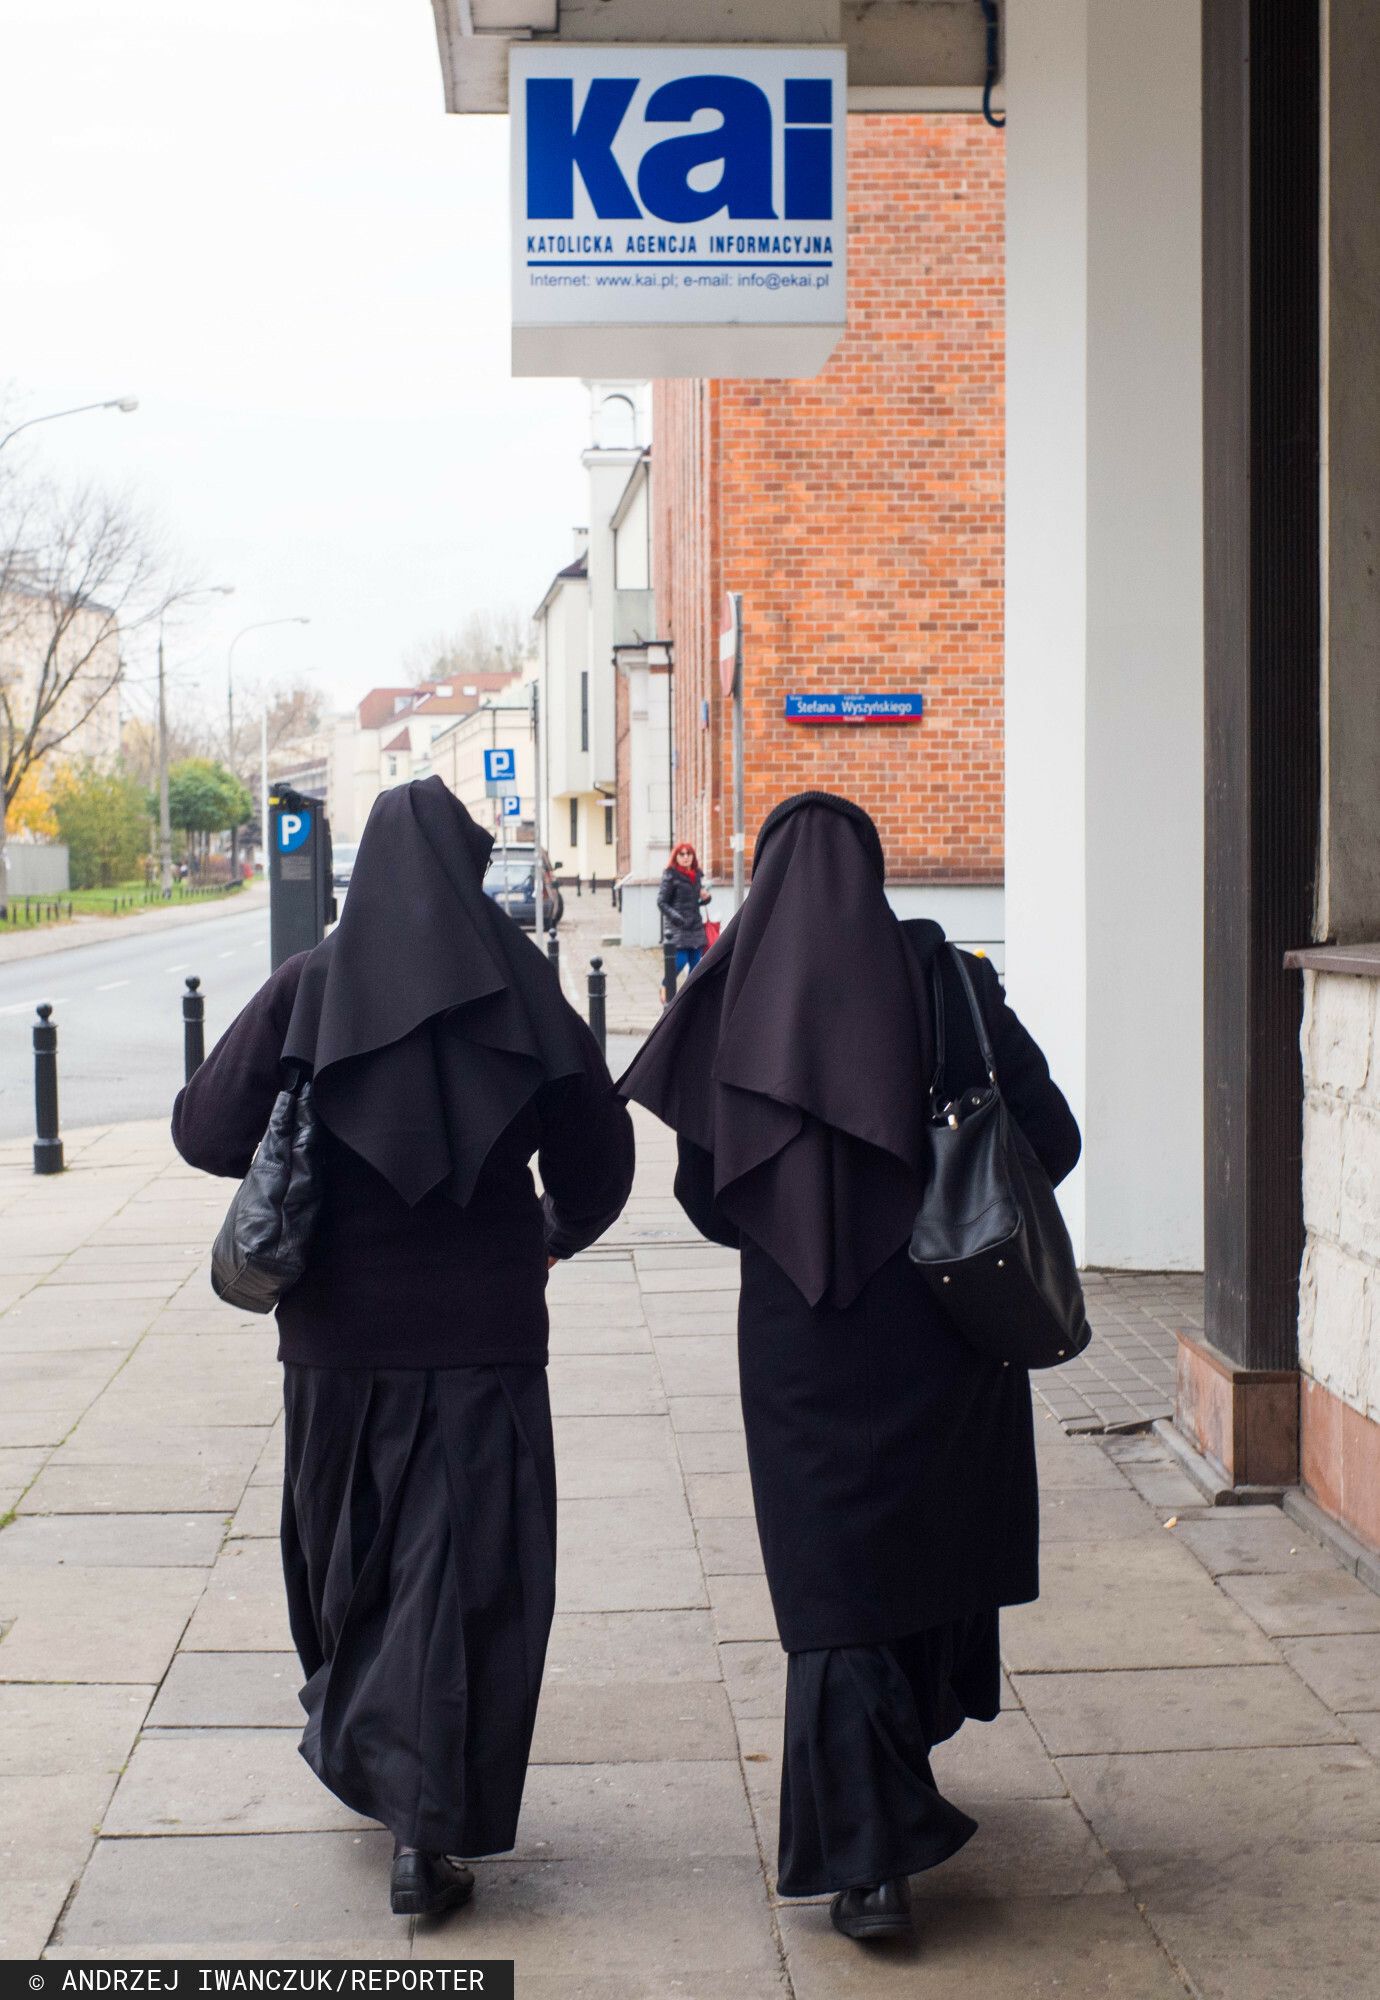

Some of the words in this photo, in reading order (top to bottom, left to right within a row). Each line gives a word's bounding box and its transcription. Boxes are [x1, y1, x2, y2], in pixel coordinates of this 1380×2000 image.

[527, 235, 614, 254] KATOLICKA
[626, 235, 697, 254] AGENCJA
[709, 235, 833, 254] INFORMACYJNA
[530, 273, 590, 288] Internet:
[596, 273, 679, 289] www.kai.pl;
[683, 273, 733, 288] e-mail:
[737, 273, 830, 290] info@ekai.pl
[797, 700, 836, 714] Stefana
[841, 700, 913, 716] Wyszyńskiego
[489, 751, 510, 778] P
[504, 796, 518, 815] P
[281, 814, 302, 846] P
